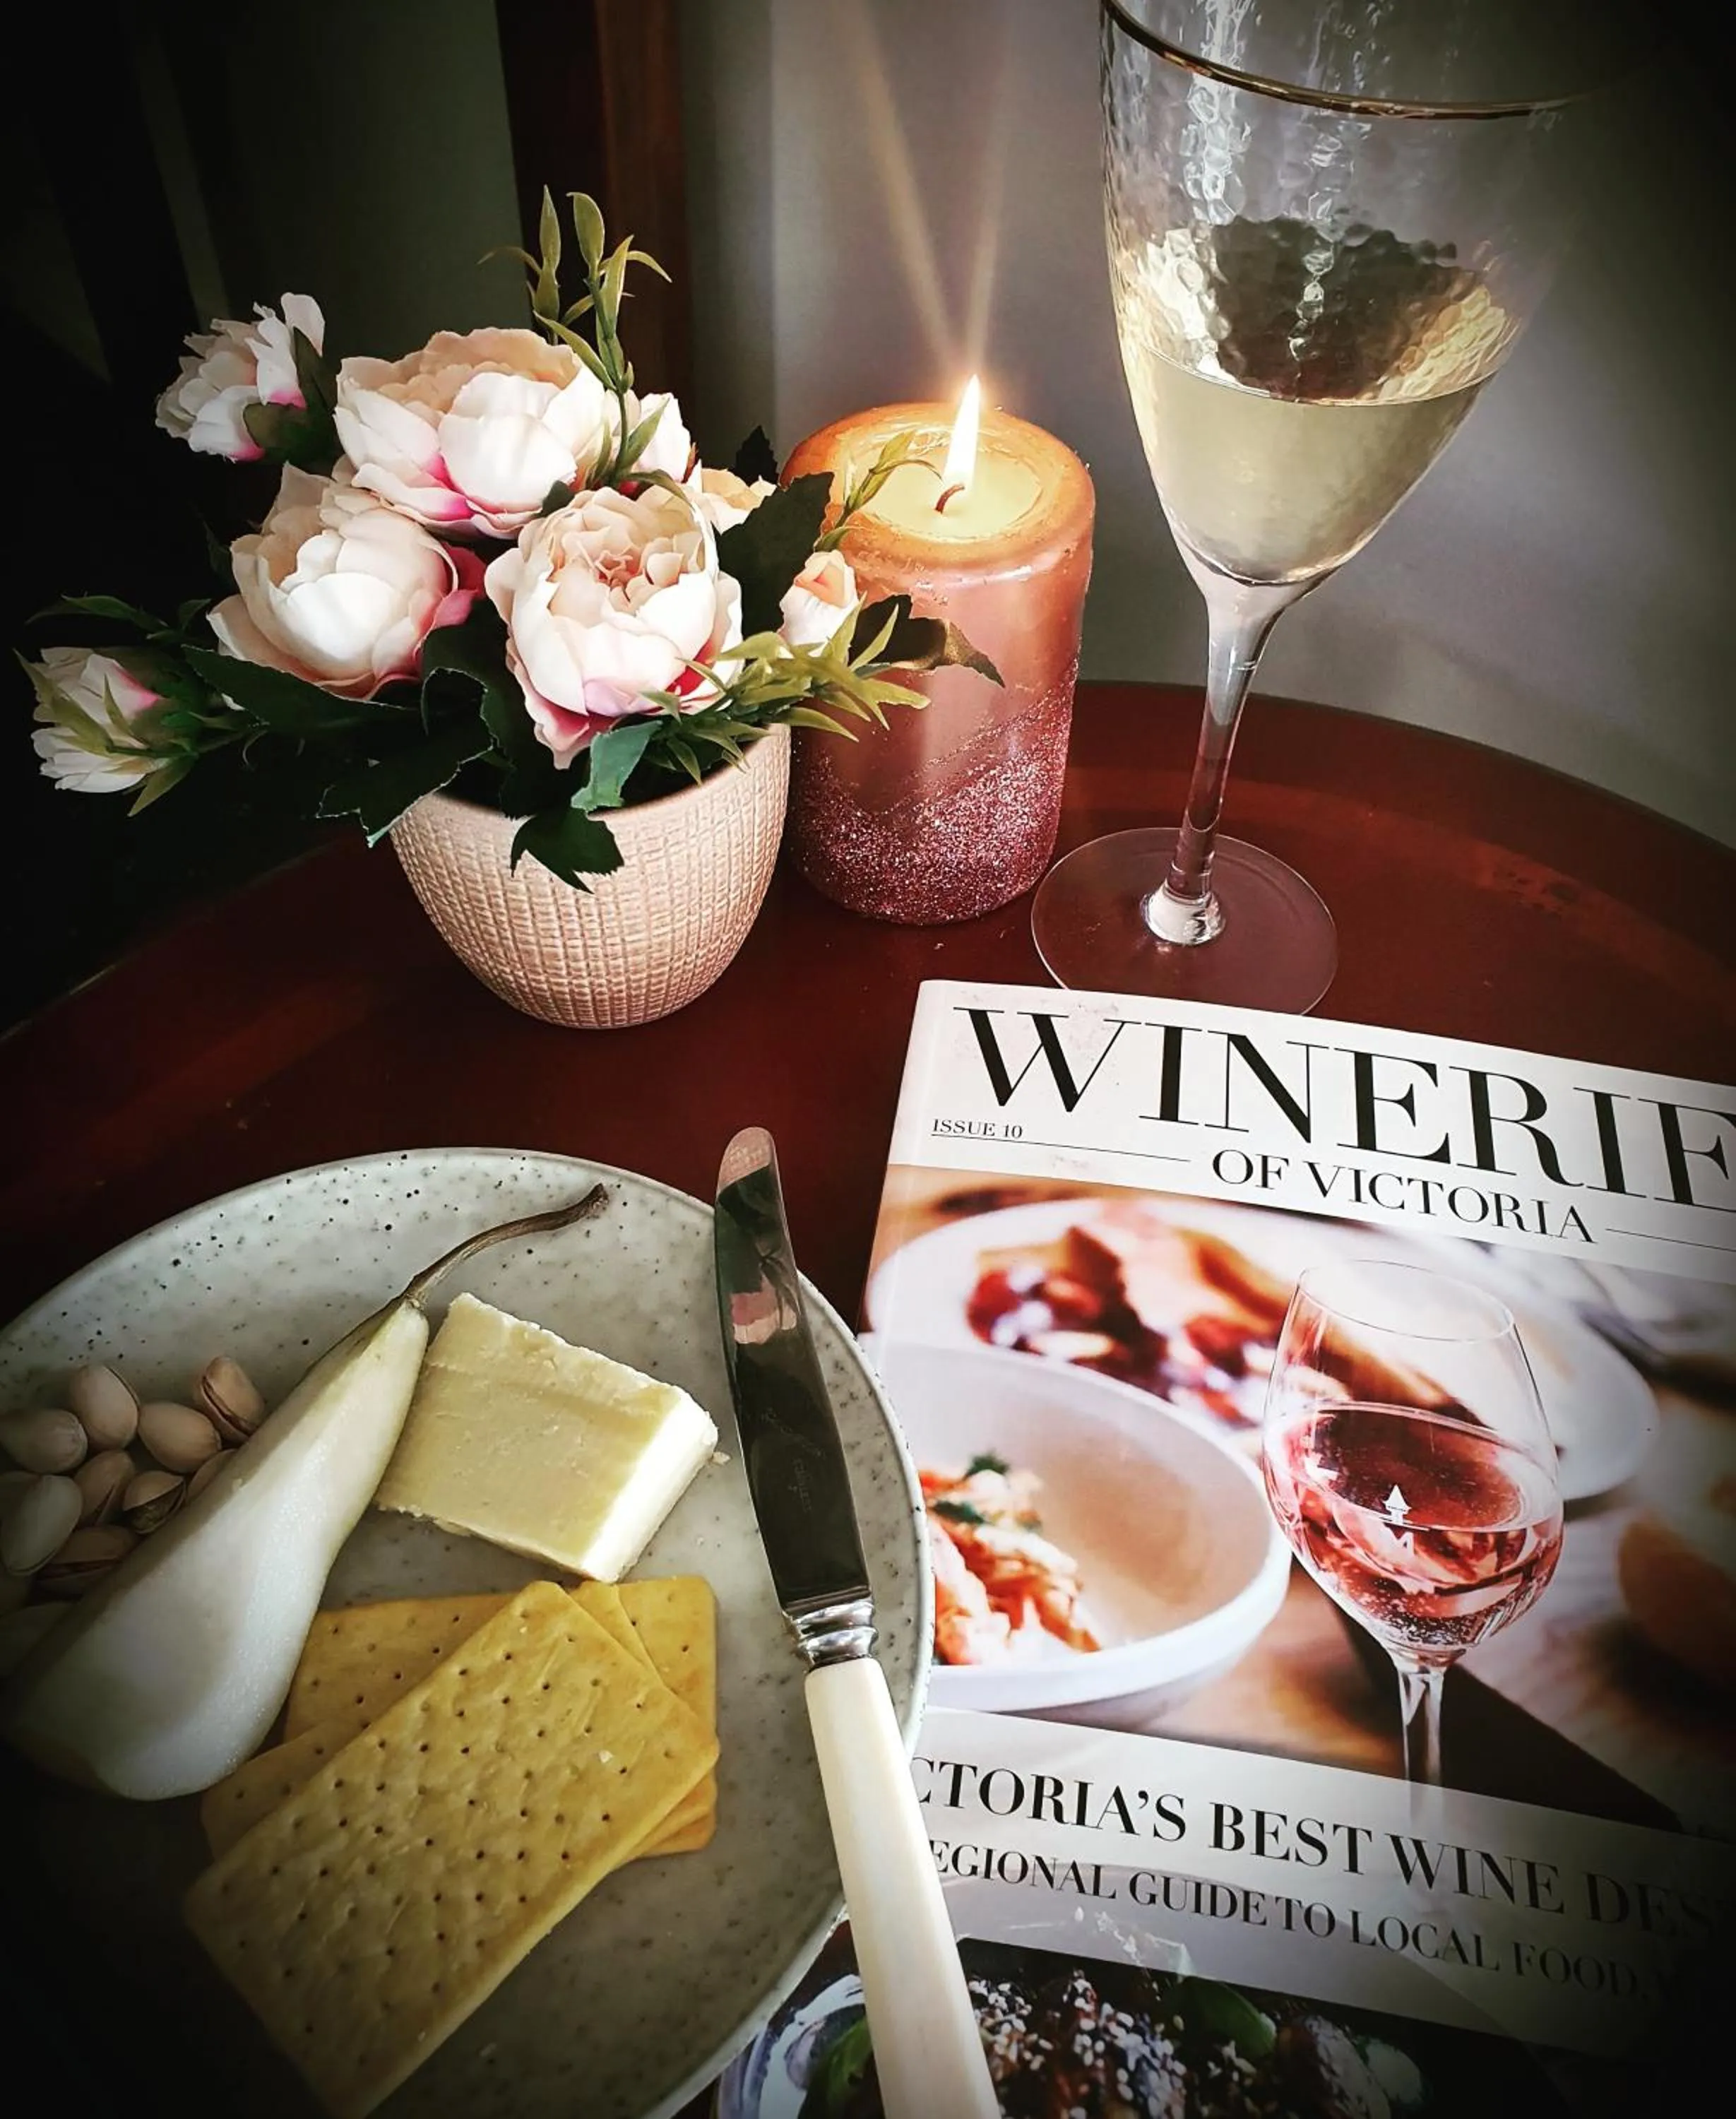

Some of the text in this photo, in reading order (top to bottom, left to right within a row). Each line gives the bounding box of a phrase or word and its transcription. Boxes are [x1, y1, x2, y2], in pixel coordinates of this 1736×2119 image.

[933, 1118, 1023, 1138] ISSUE 10
[954, 1007, 1735, 1212] WINERIE
[1213, 1149, 1594, 1242] OF VICTORIA
[912, 1757, 1735, 1939] CTORIA'S BEST WINE DES
[929, 1839, 1116, 1899] EGIONAL
[1129, 1872, 1267, 1925] GUIDE
[1275, 1897, 1336, 1937] TO
[1350, 1911, 1499, 1971] LOCAL
